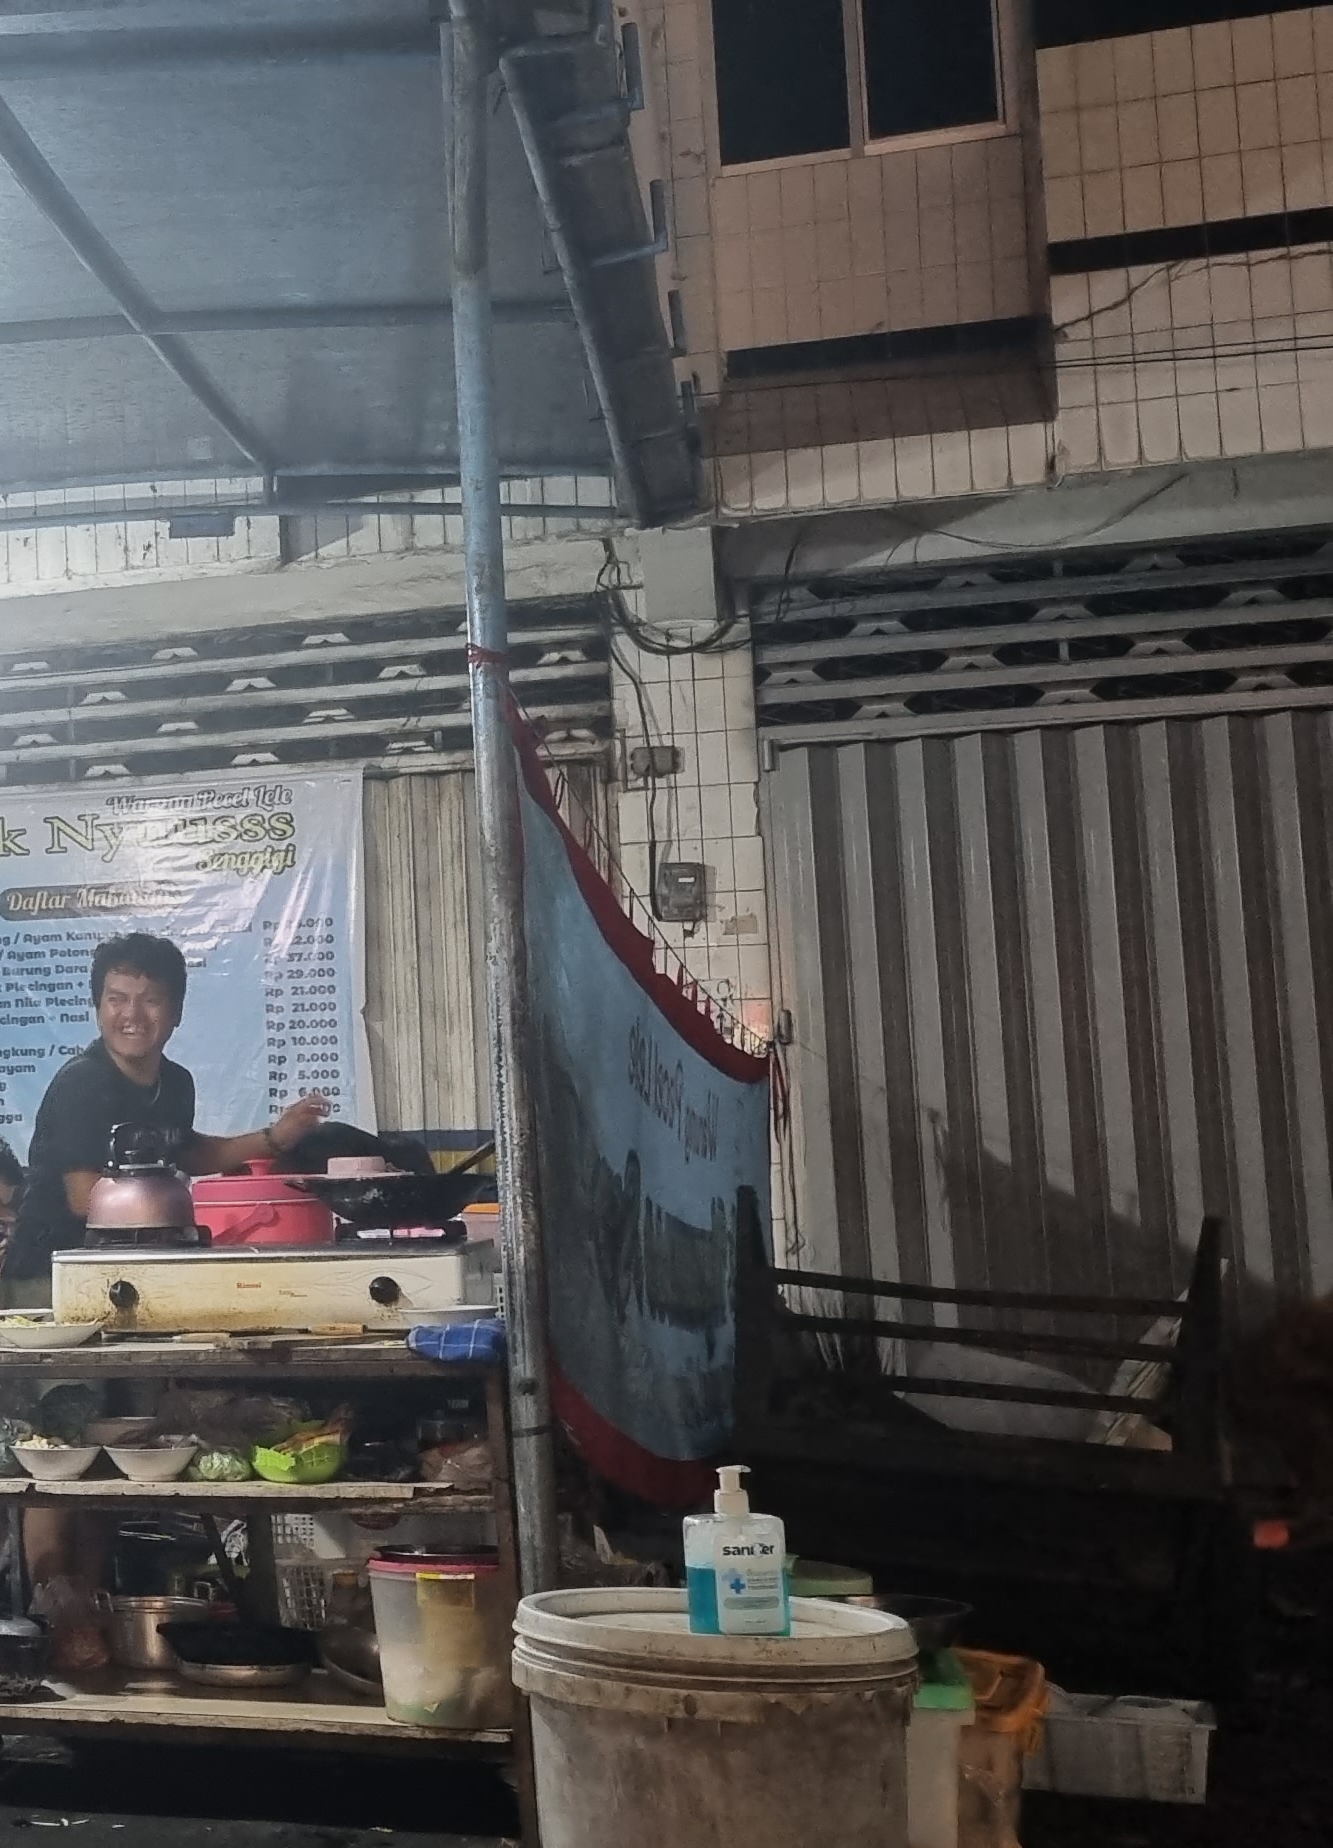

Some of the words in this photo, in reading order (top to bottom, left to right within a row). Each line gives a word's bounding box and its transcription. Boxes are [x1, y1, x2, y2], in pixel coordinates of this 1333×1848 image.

[253, 785, 293, 812] Lele
[6, 887, 69, 915] Daftar
[23, 934, 62, 945] Ayam
[7, 950, 46, 961] Ayam
[55, 964, 88, 974] Dara
[265, 987, 284, 998] Rp
[290, 984, 336, 996] 21.000
[265, 1003, 285, 1015] Rp
[291, 1001, 337, 1013] 21.000
[265, 1020, 285, 1032] Rp
[288, 1018, 338, 1030] 20.000
[267, 1037, 286, 1049] Rp
[290, 1034, 338, 1046] 10.000
[267, 1054, 287, 1067] Rp
[268, 1070, 288, 1083] Rp
[297, 1068, 340, 1080] 5.000
[269, 1087, 289, 1100] Rp
